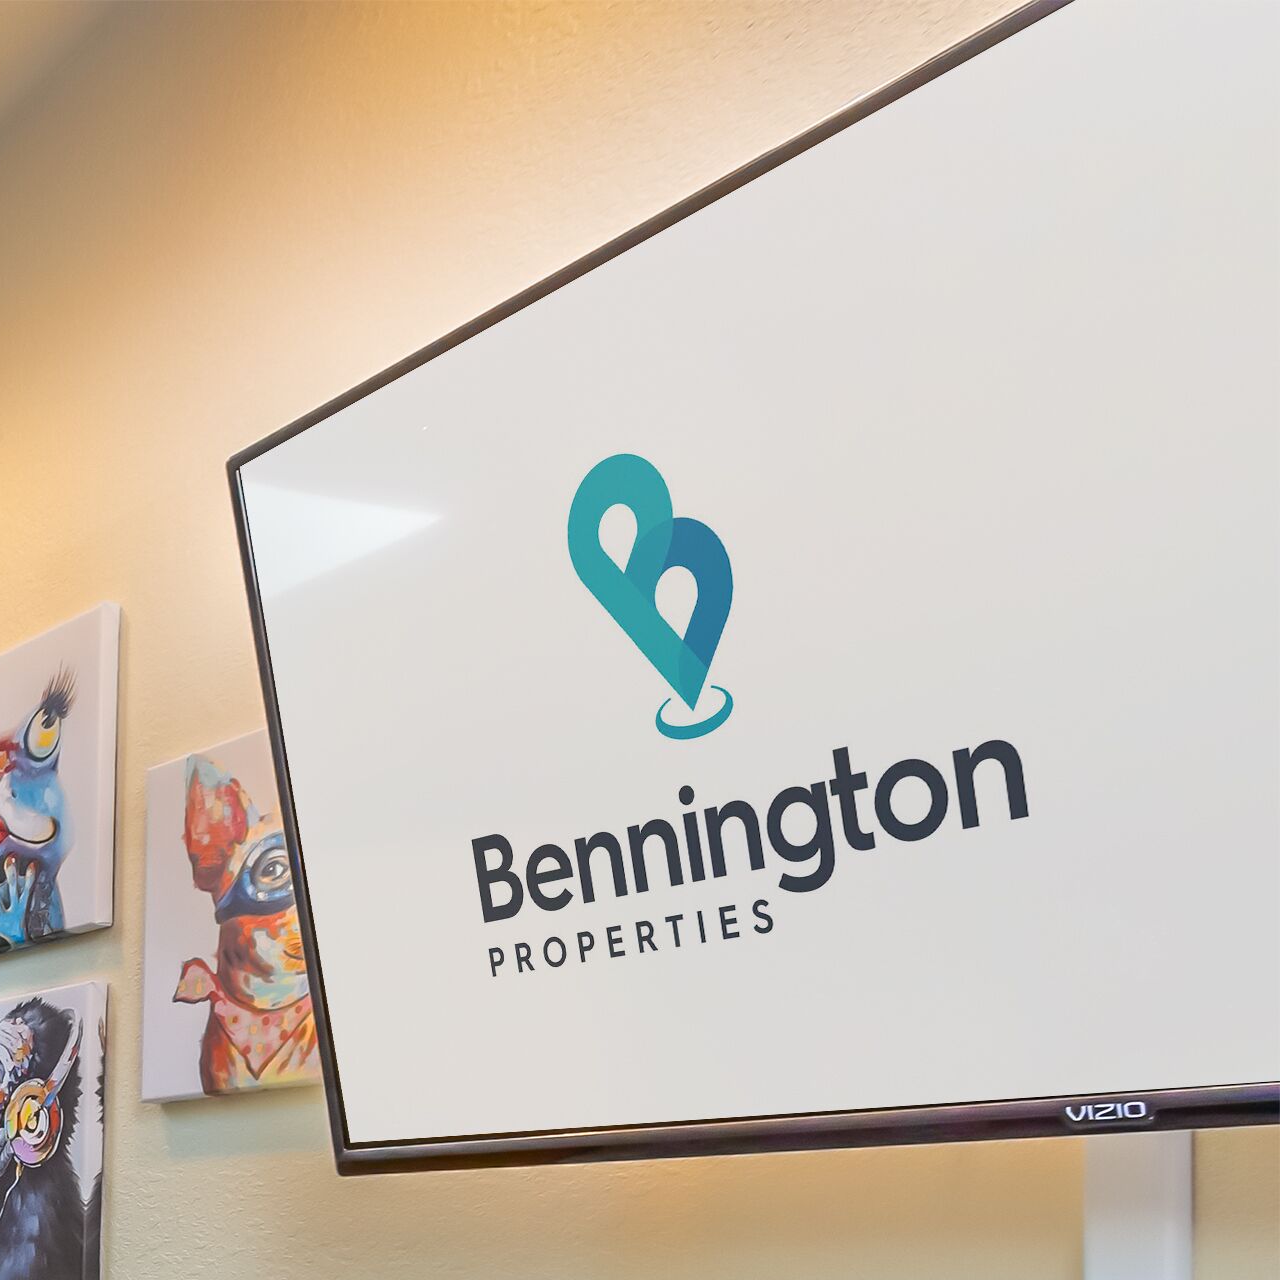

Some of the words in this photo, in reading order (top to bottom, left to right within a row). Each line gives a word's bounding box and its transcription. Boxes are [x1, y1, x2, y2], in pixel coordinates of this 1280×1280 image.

[471, 738, 1029, 923] Bennington
[488, 899, 774, 977] PROPERTIES
[1065, 1101, 1147, 1122] VIZIO
